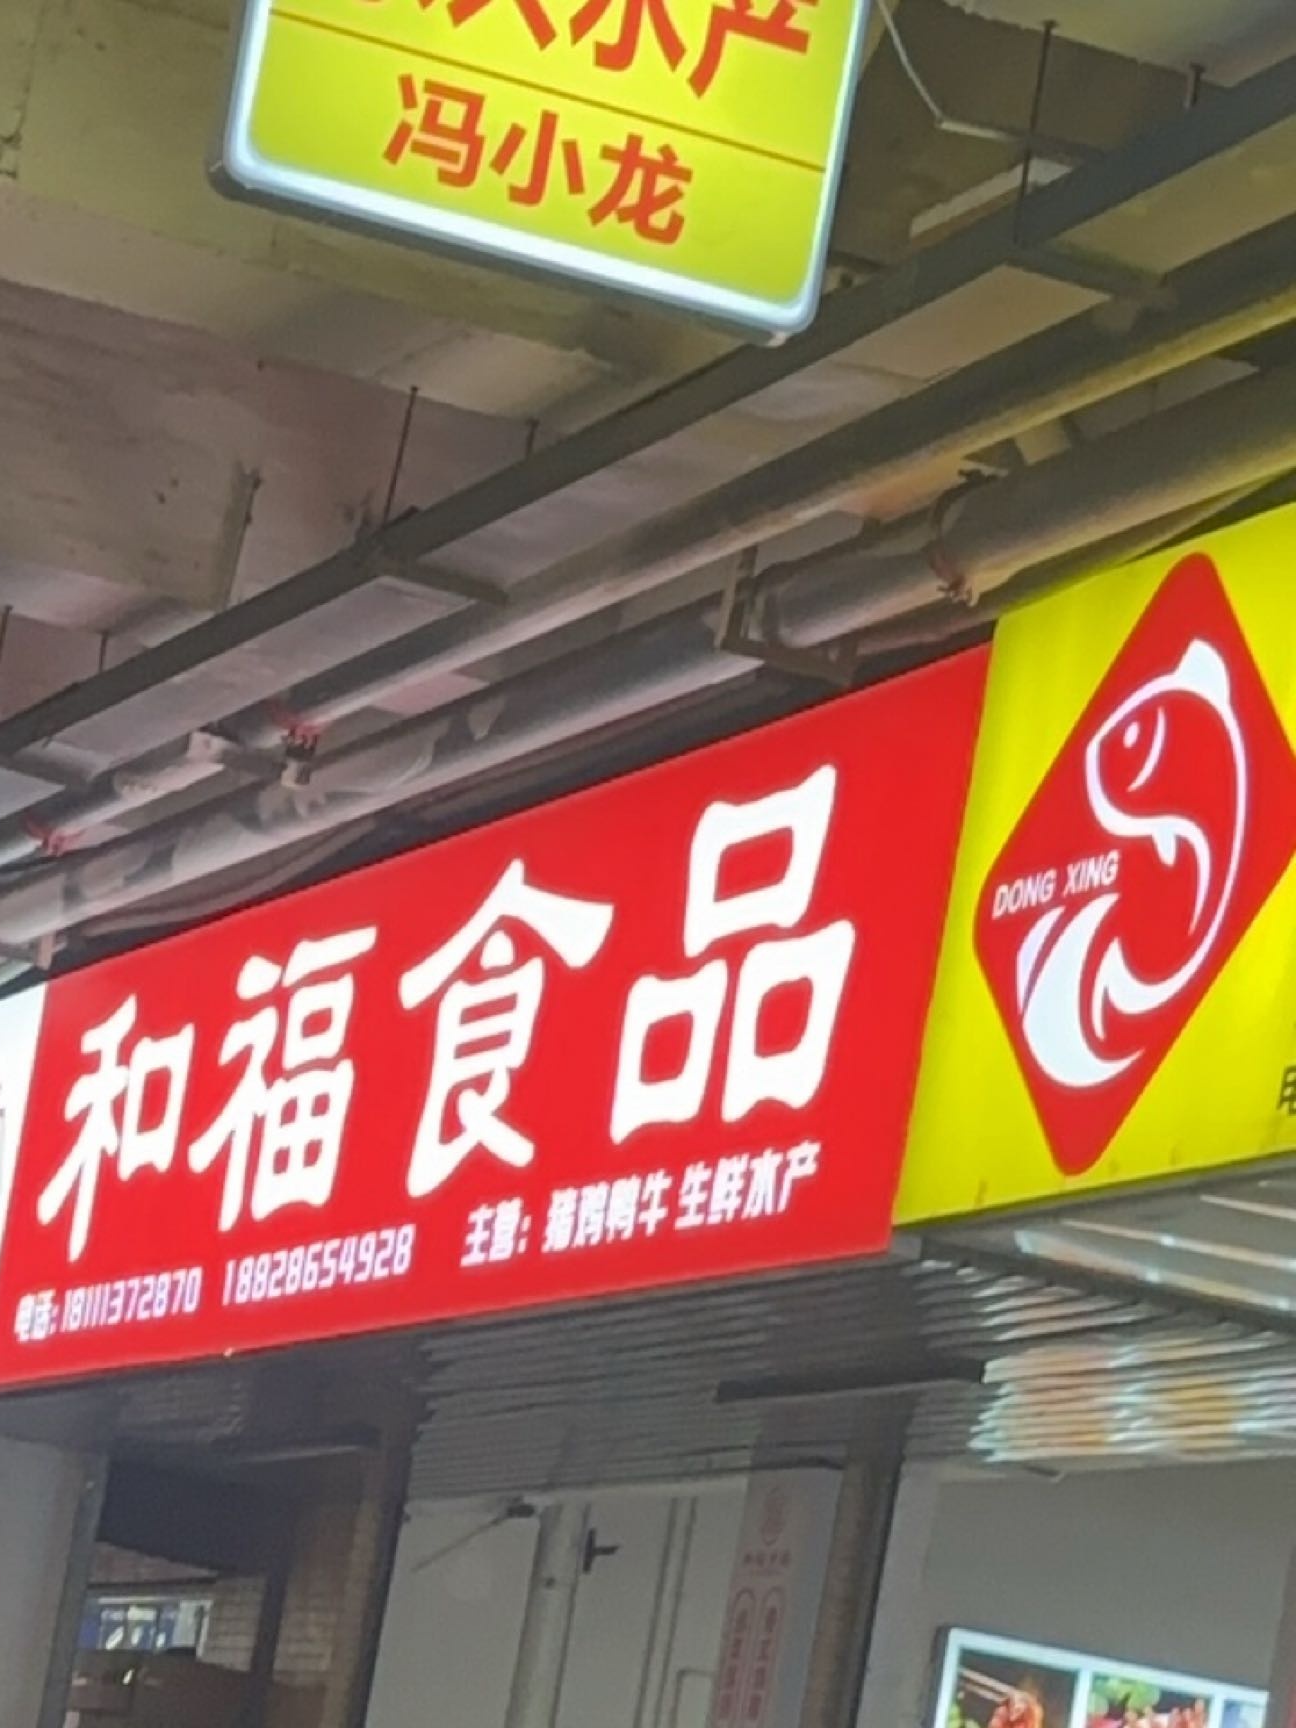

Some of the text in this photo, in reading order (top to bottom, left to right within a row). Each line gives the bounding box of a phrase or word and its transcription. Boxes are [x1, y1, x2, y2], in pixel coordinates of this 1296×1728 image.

[382, 73, 693, 245] 冯小龙
[991, 849, 1121, 920] DONG XING
[37, 764, 855, 1263] 和福食品
[221, 1225, 415, 1307] 18828654928
